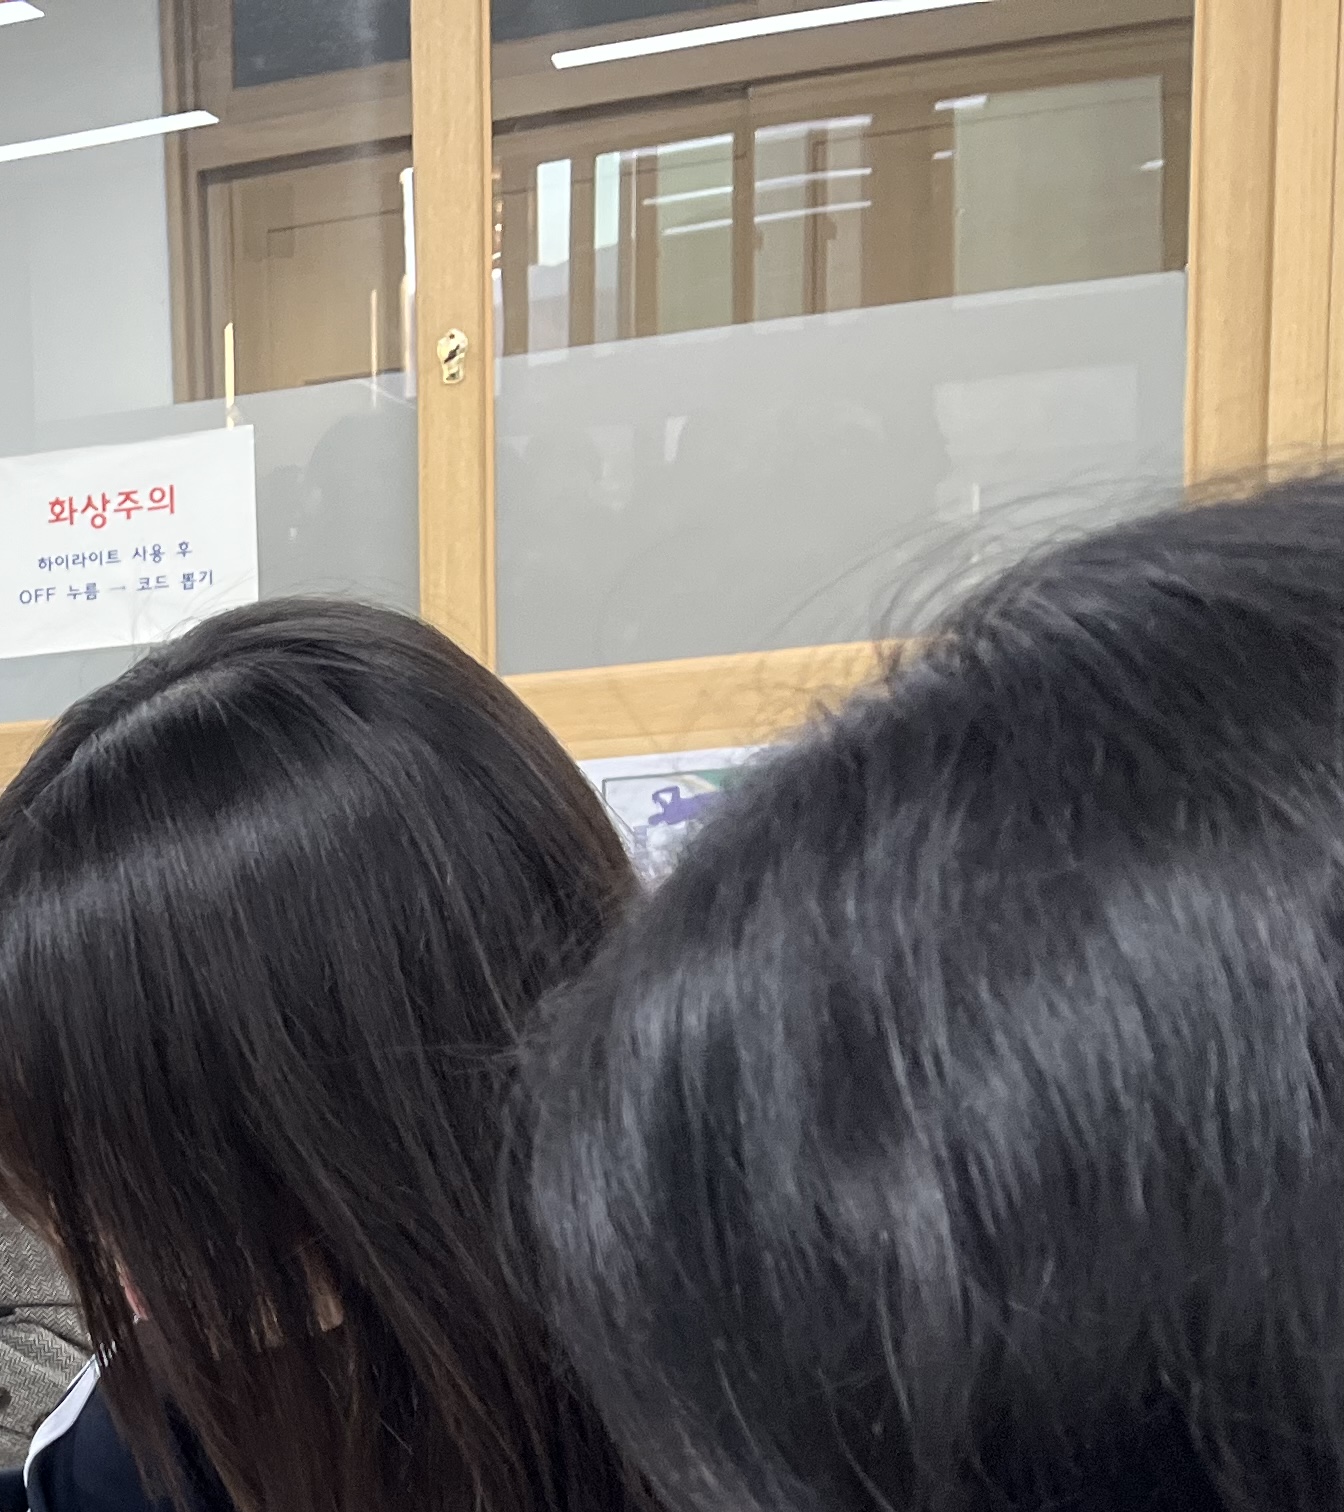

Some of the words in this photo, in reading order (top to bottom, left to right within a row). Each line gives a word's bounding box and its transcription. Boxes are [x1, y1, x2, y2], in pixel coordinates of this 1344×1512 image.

[48, 484, 176, 529] 화상주의
[37, 549, 121, 571] 하이라이트
[132, 543, 163, 563] 사용
[176, 541, 193, 557] 후
[19, 587, 56, 604] OFF
[66, 582, 99, 600] 누름
[136, 576, 169, 592] 코드
[181, 569, 213, 590] 뽑기
